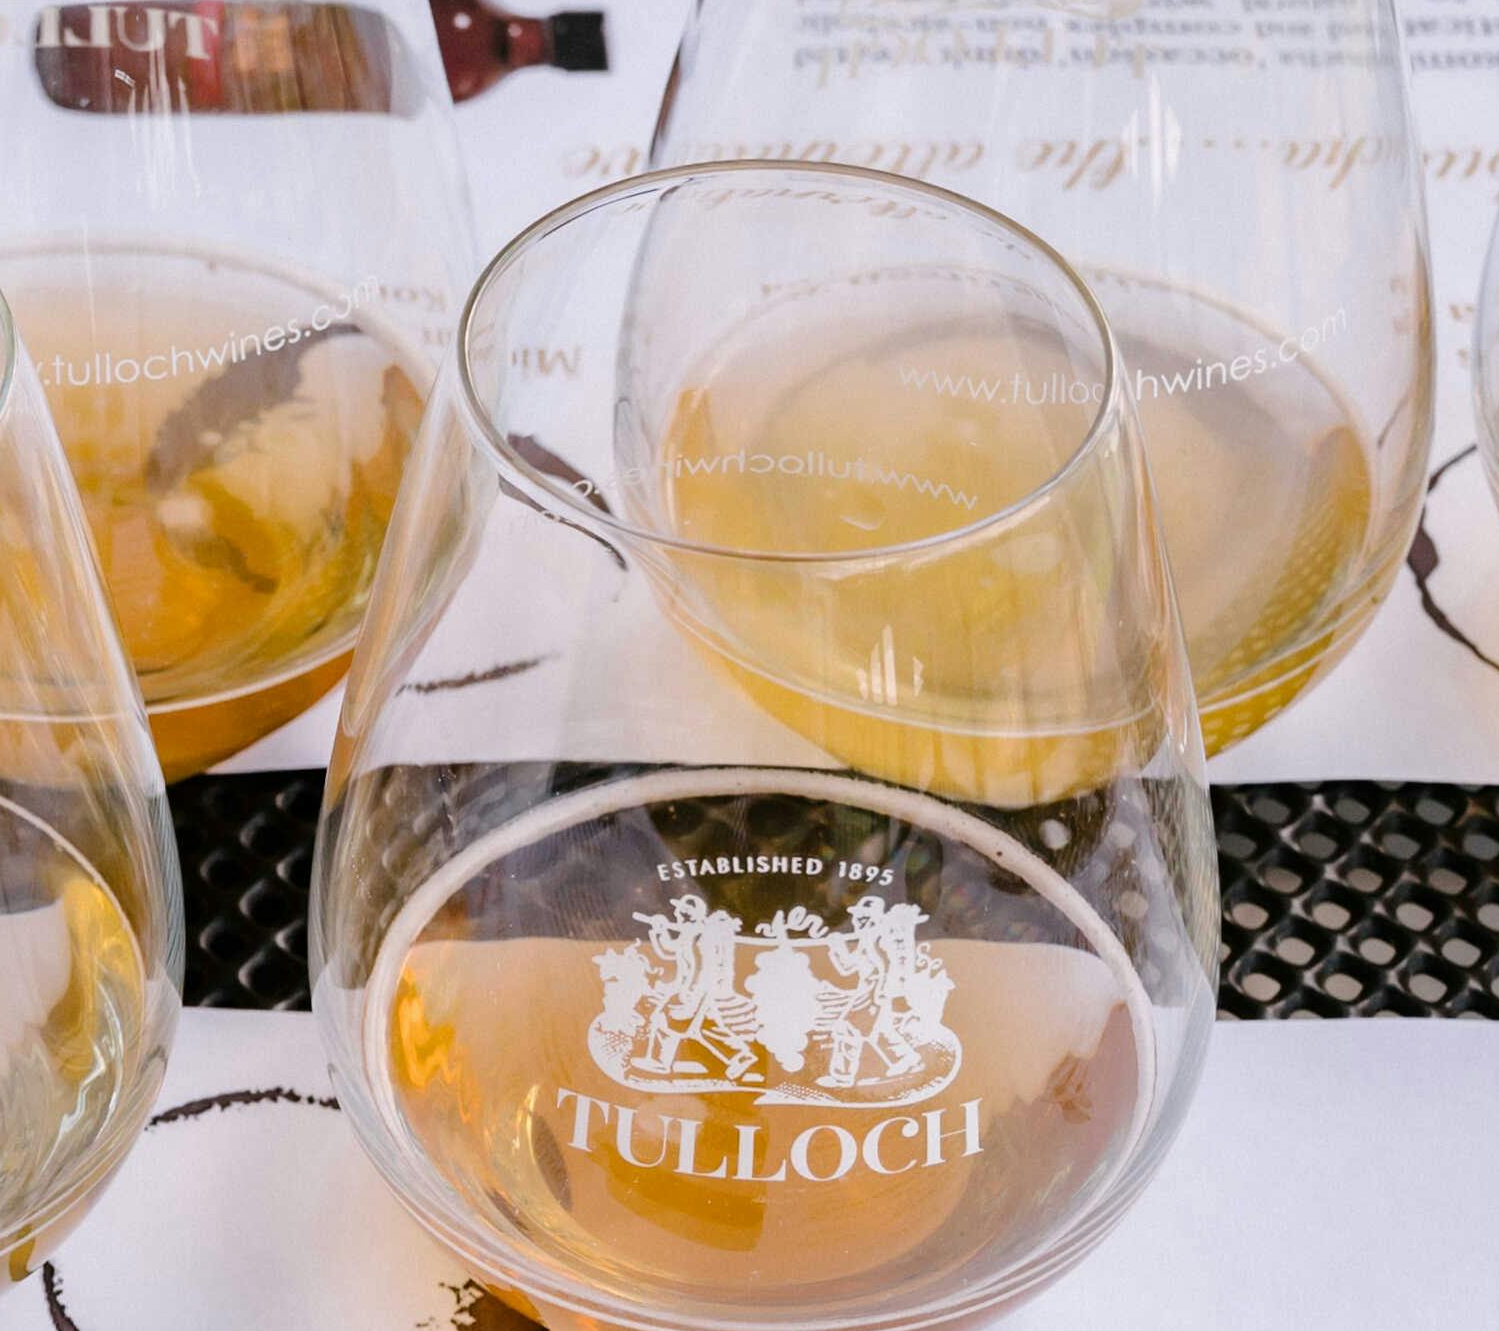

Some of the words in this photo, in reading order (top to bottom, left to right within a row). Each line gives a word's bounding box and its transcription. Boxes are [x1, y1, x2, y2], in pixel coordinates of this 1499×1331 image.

[657, 855, 824, 884] ESTABLISHED
[837, 860, 896, 888] 1895
[555, 1086, 985, 1184] TULLOCH
